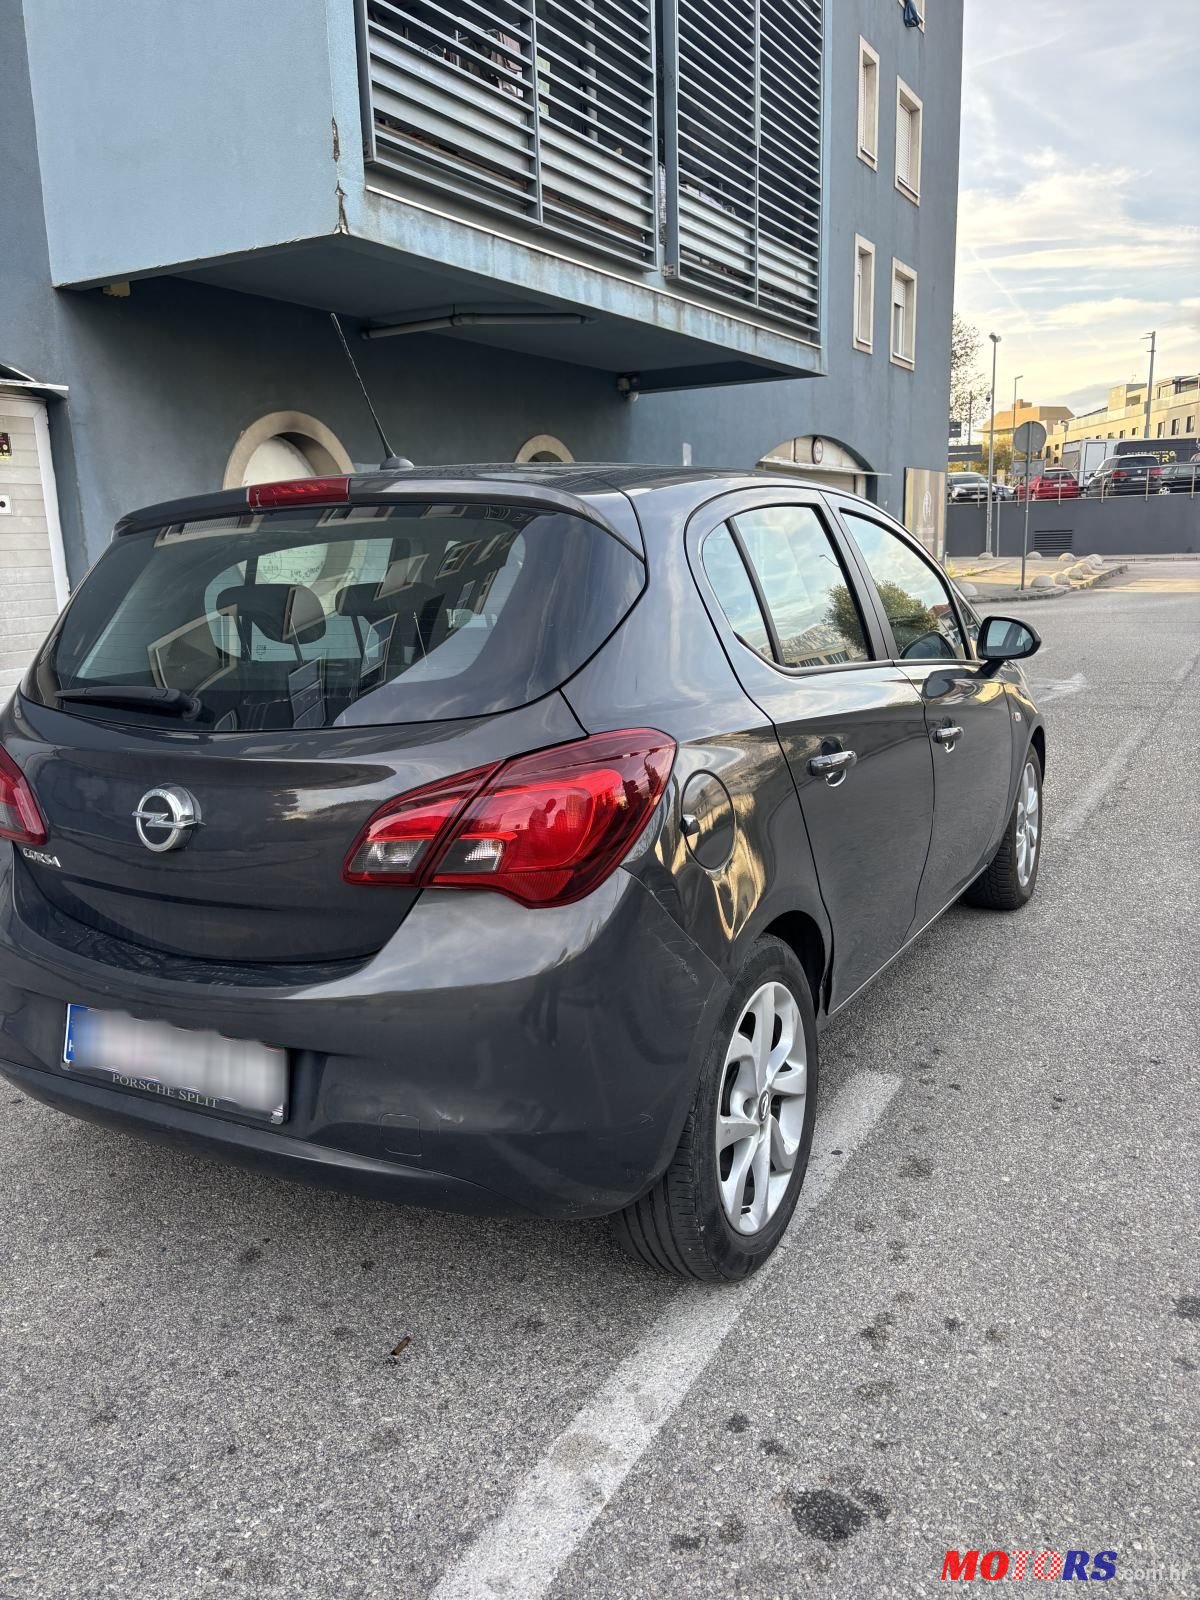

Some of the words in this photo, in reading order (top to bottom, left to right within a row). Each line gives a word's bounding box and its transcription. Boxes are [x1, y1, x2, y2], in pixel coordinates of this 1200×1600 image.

[22, 847, 61, 868] CORSA
[112, 1073, 175, 1098] PORSCHE
[178, 1089, 220, 1109] SPLIT
